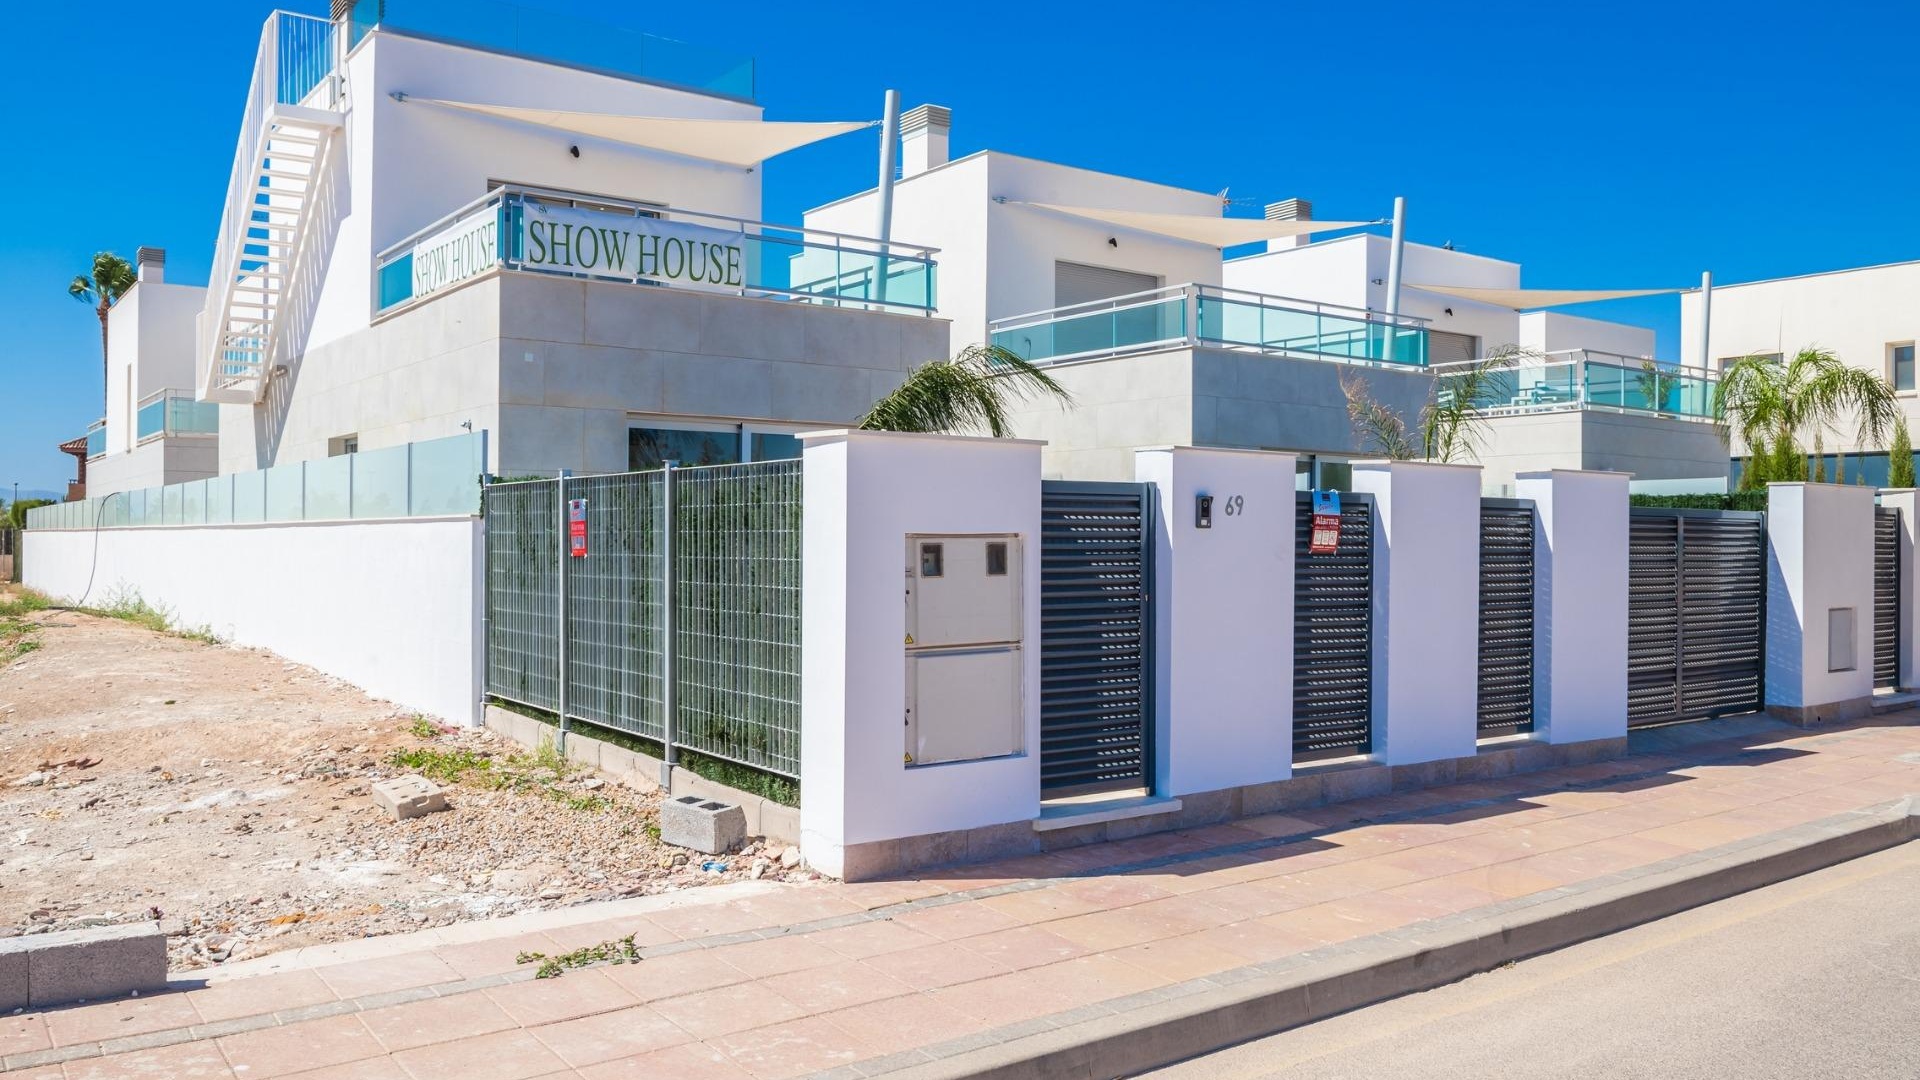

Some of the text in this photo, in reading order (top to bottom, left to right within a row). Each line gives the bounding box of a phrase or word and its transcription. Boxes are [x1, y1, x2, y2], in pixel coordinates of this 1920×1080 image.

[415, 220, 496, 299] SHOW HOUSE
[529, 219, 742, 287] SHOW HOUSE
[1224, 494, 1244, 517] 69
[1315, 515, 1339, 526] Alarma
